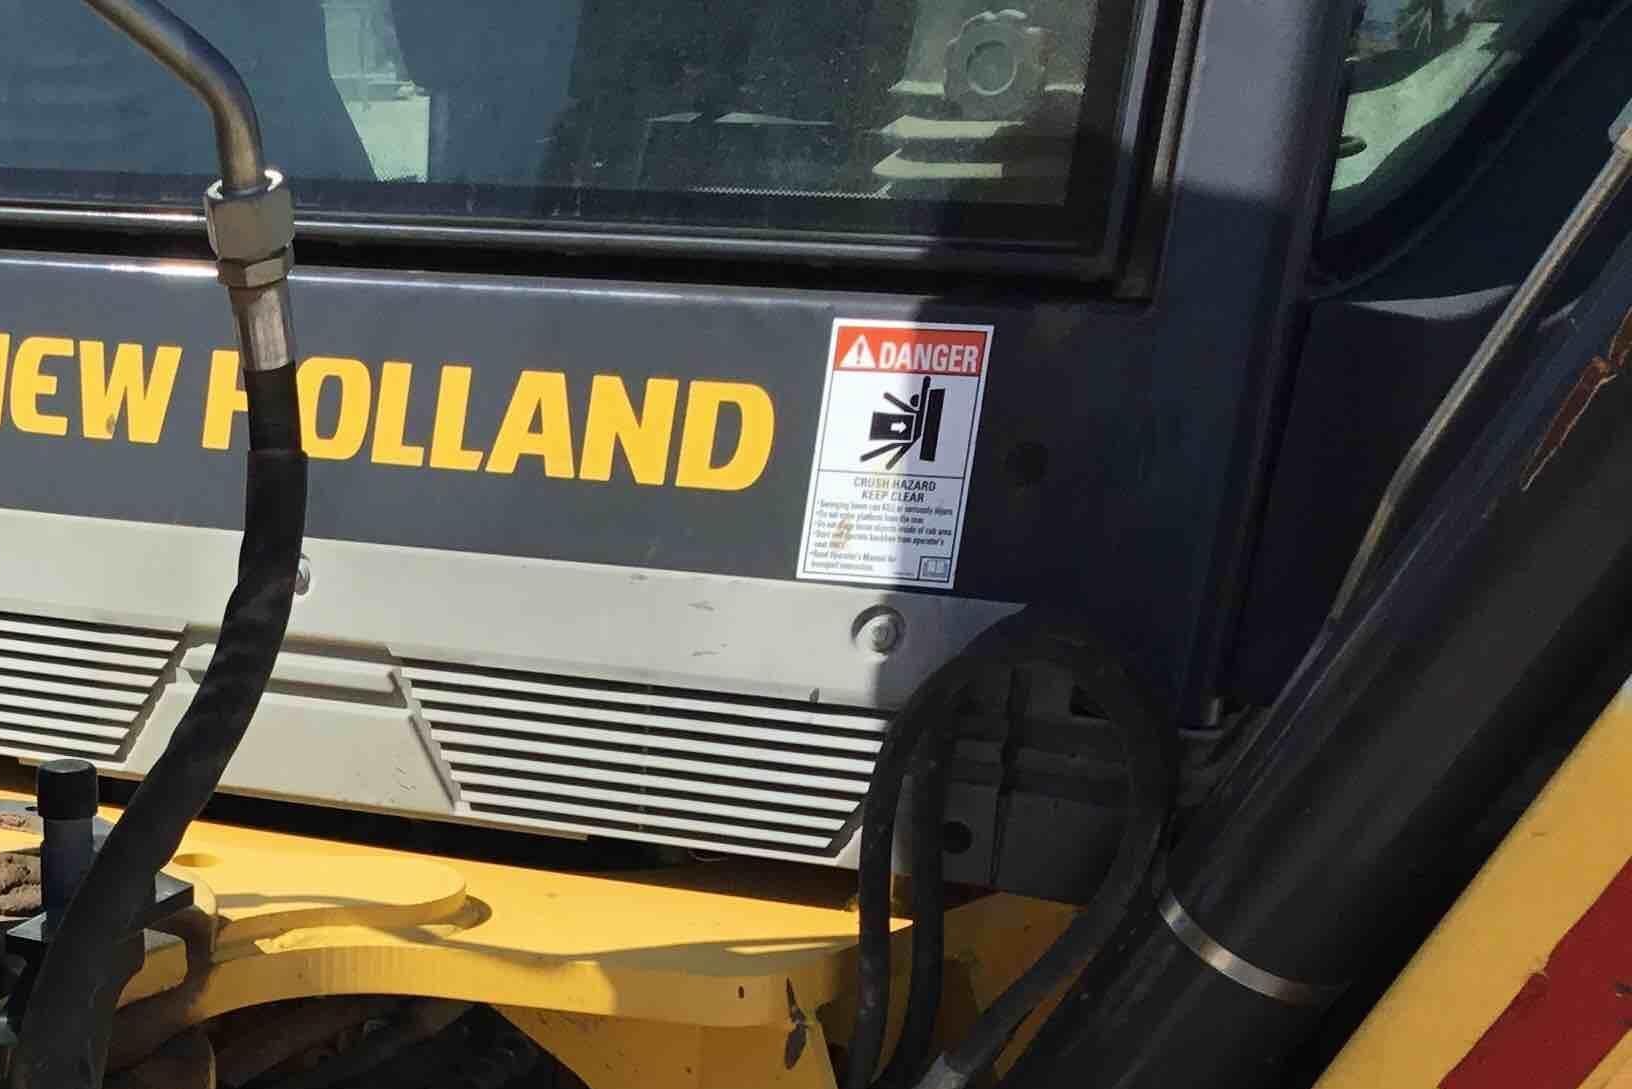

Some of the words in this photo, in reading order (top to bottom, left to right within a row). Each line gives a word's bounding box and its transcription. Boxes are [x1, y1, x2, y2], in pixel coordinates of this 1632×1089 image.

[879, 341, 978, 374] DANGER
[853, 477, 889, 489] CRUSH
[892, 479, 936, 491] HAZARD
[861, 490, 888, 500] KEEP
[890, 492, 924, 502] CLEAR
